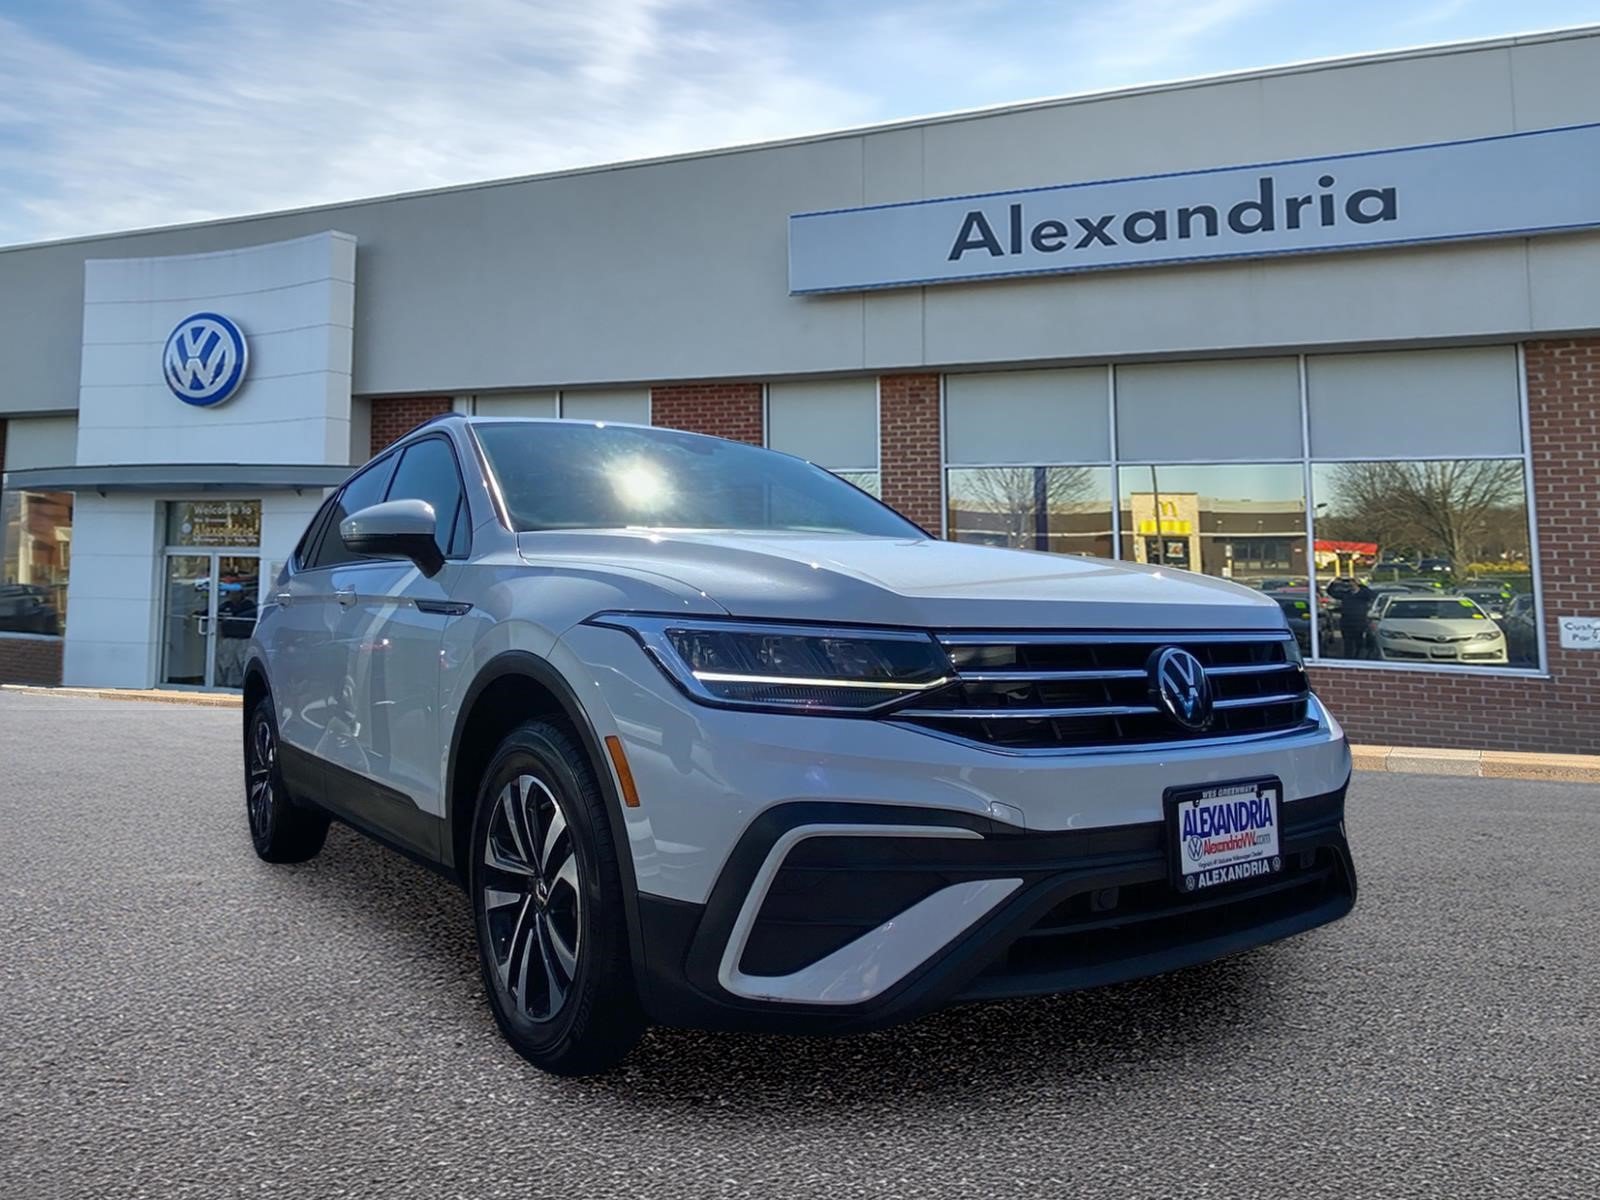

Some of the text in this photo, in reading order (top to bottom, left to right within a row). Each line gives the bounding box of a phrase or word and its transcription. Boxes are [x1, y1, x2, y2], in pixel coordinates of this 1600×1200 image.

[947, 174, 1398, 262] Alexandria
[1182, 798, 1273, 842] ALEXANDRIA
[1198, 859, 1270, 888] ALEXANDRIA
